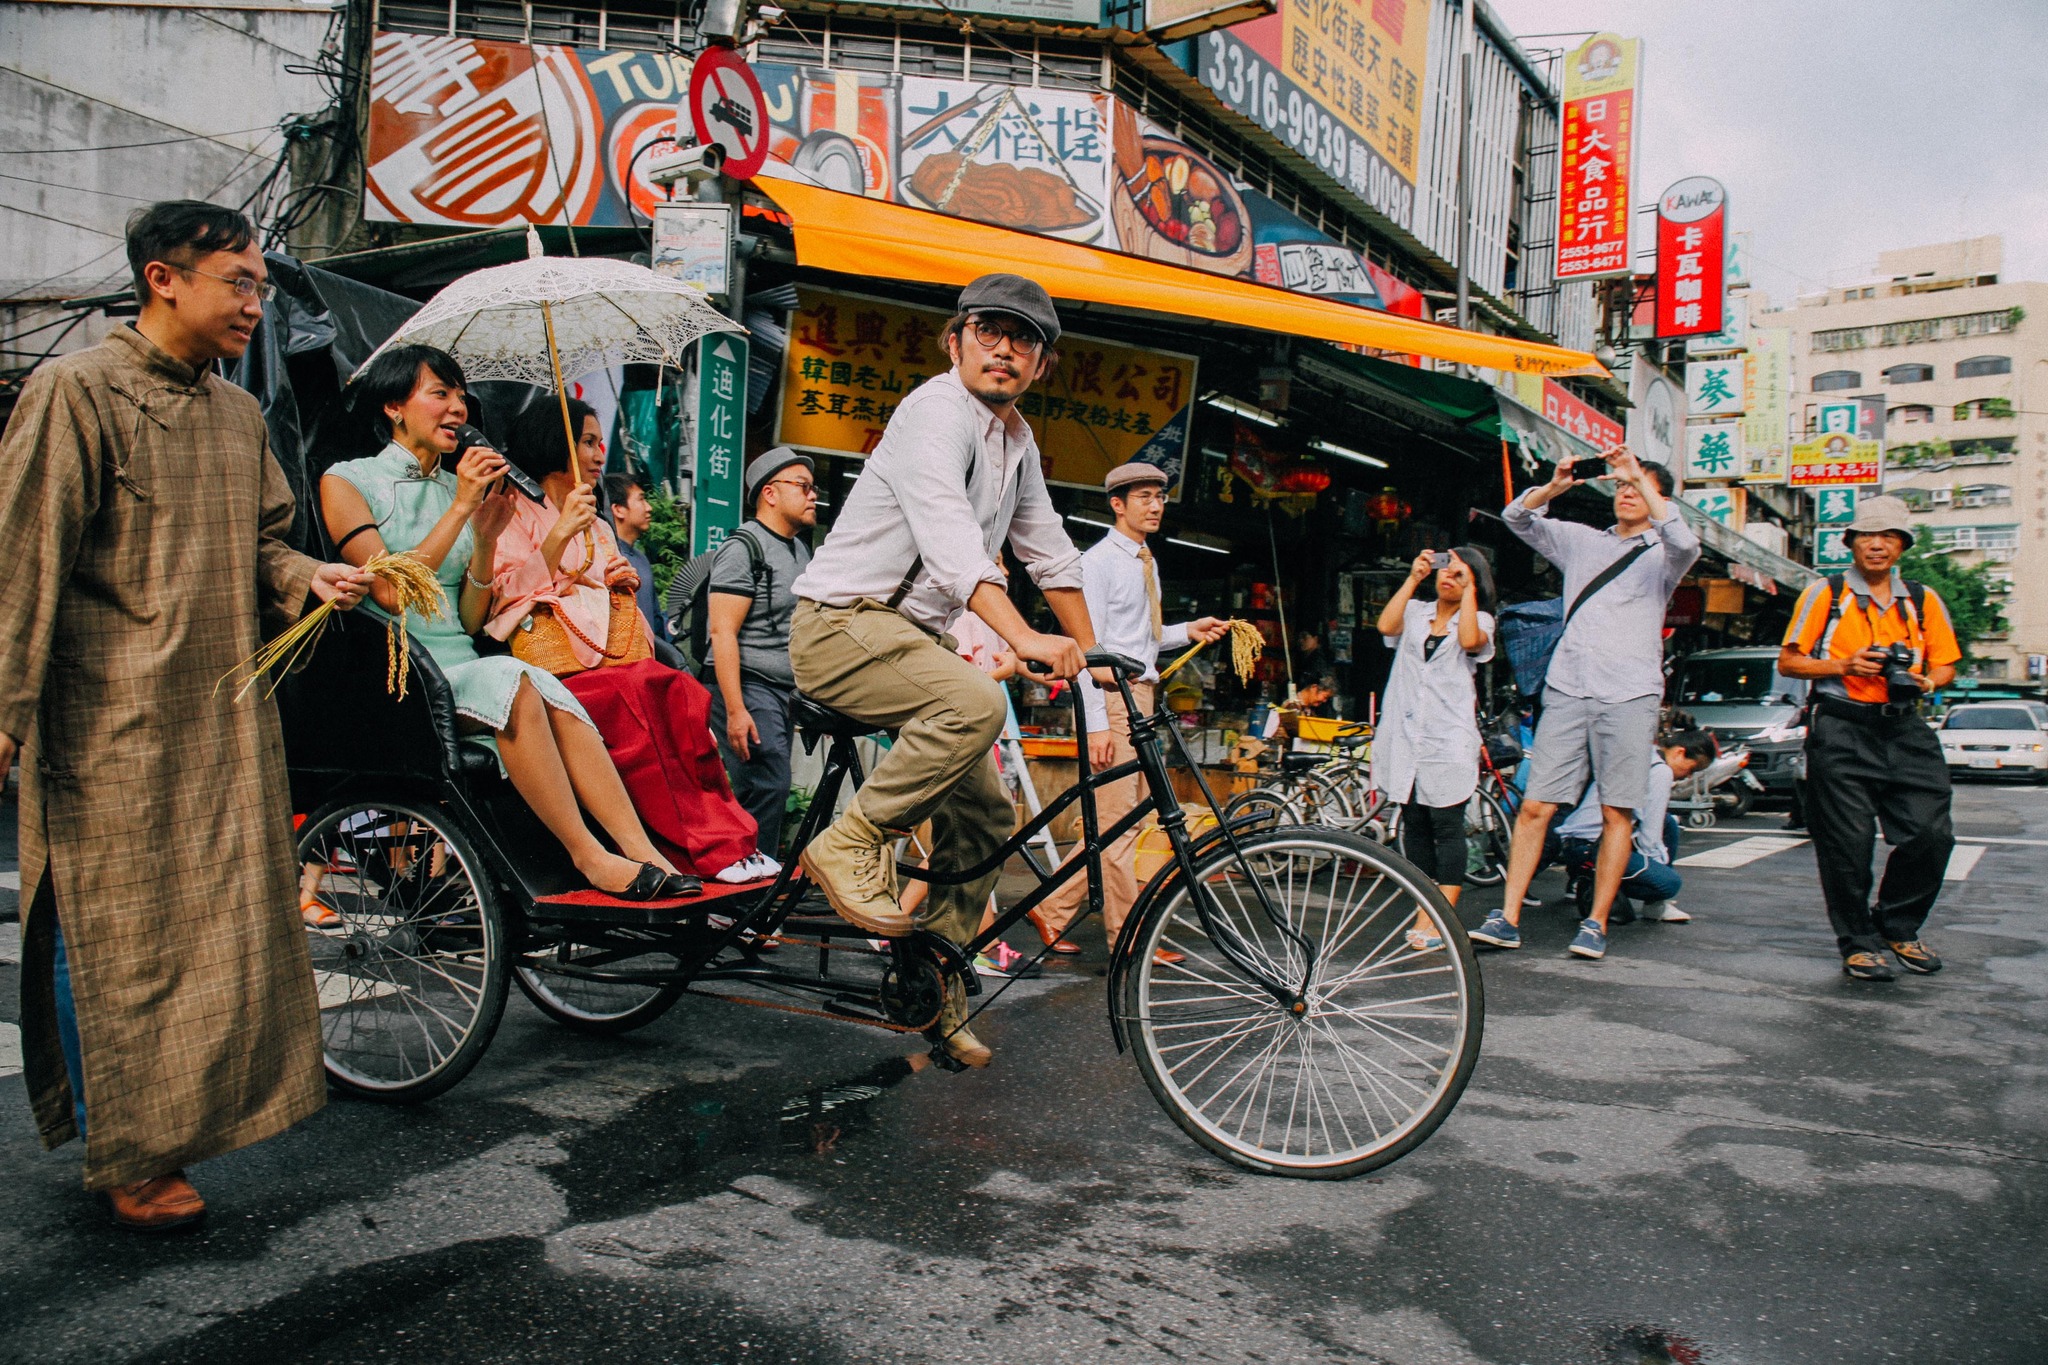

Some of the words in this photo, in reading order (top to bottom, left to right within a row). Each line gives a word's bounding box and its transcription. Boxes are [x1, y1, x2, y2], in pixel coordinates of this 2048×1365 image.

[908, 91, 1103, 163] 大稻埕
[1577, 98, 1612, 241] 日大食品行
[1674, 227, 1703, 328] 卡瓦咖啡
[1047, 350, 1183, 413] 限公司
